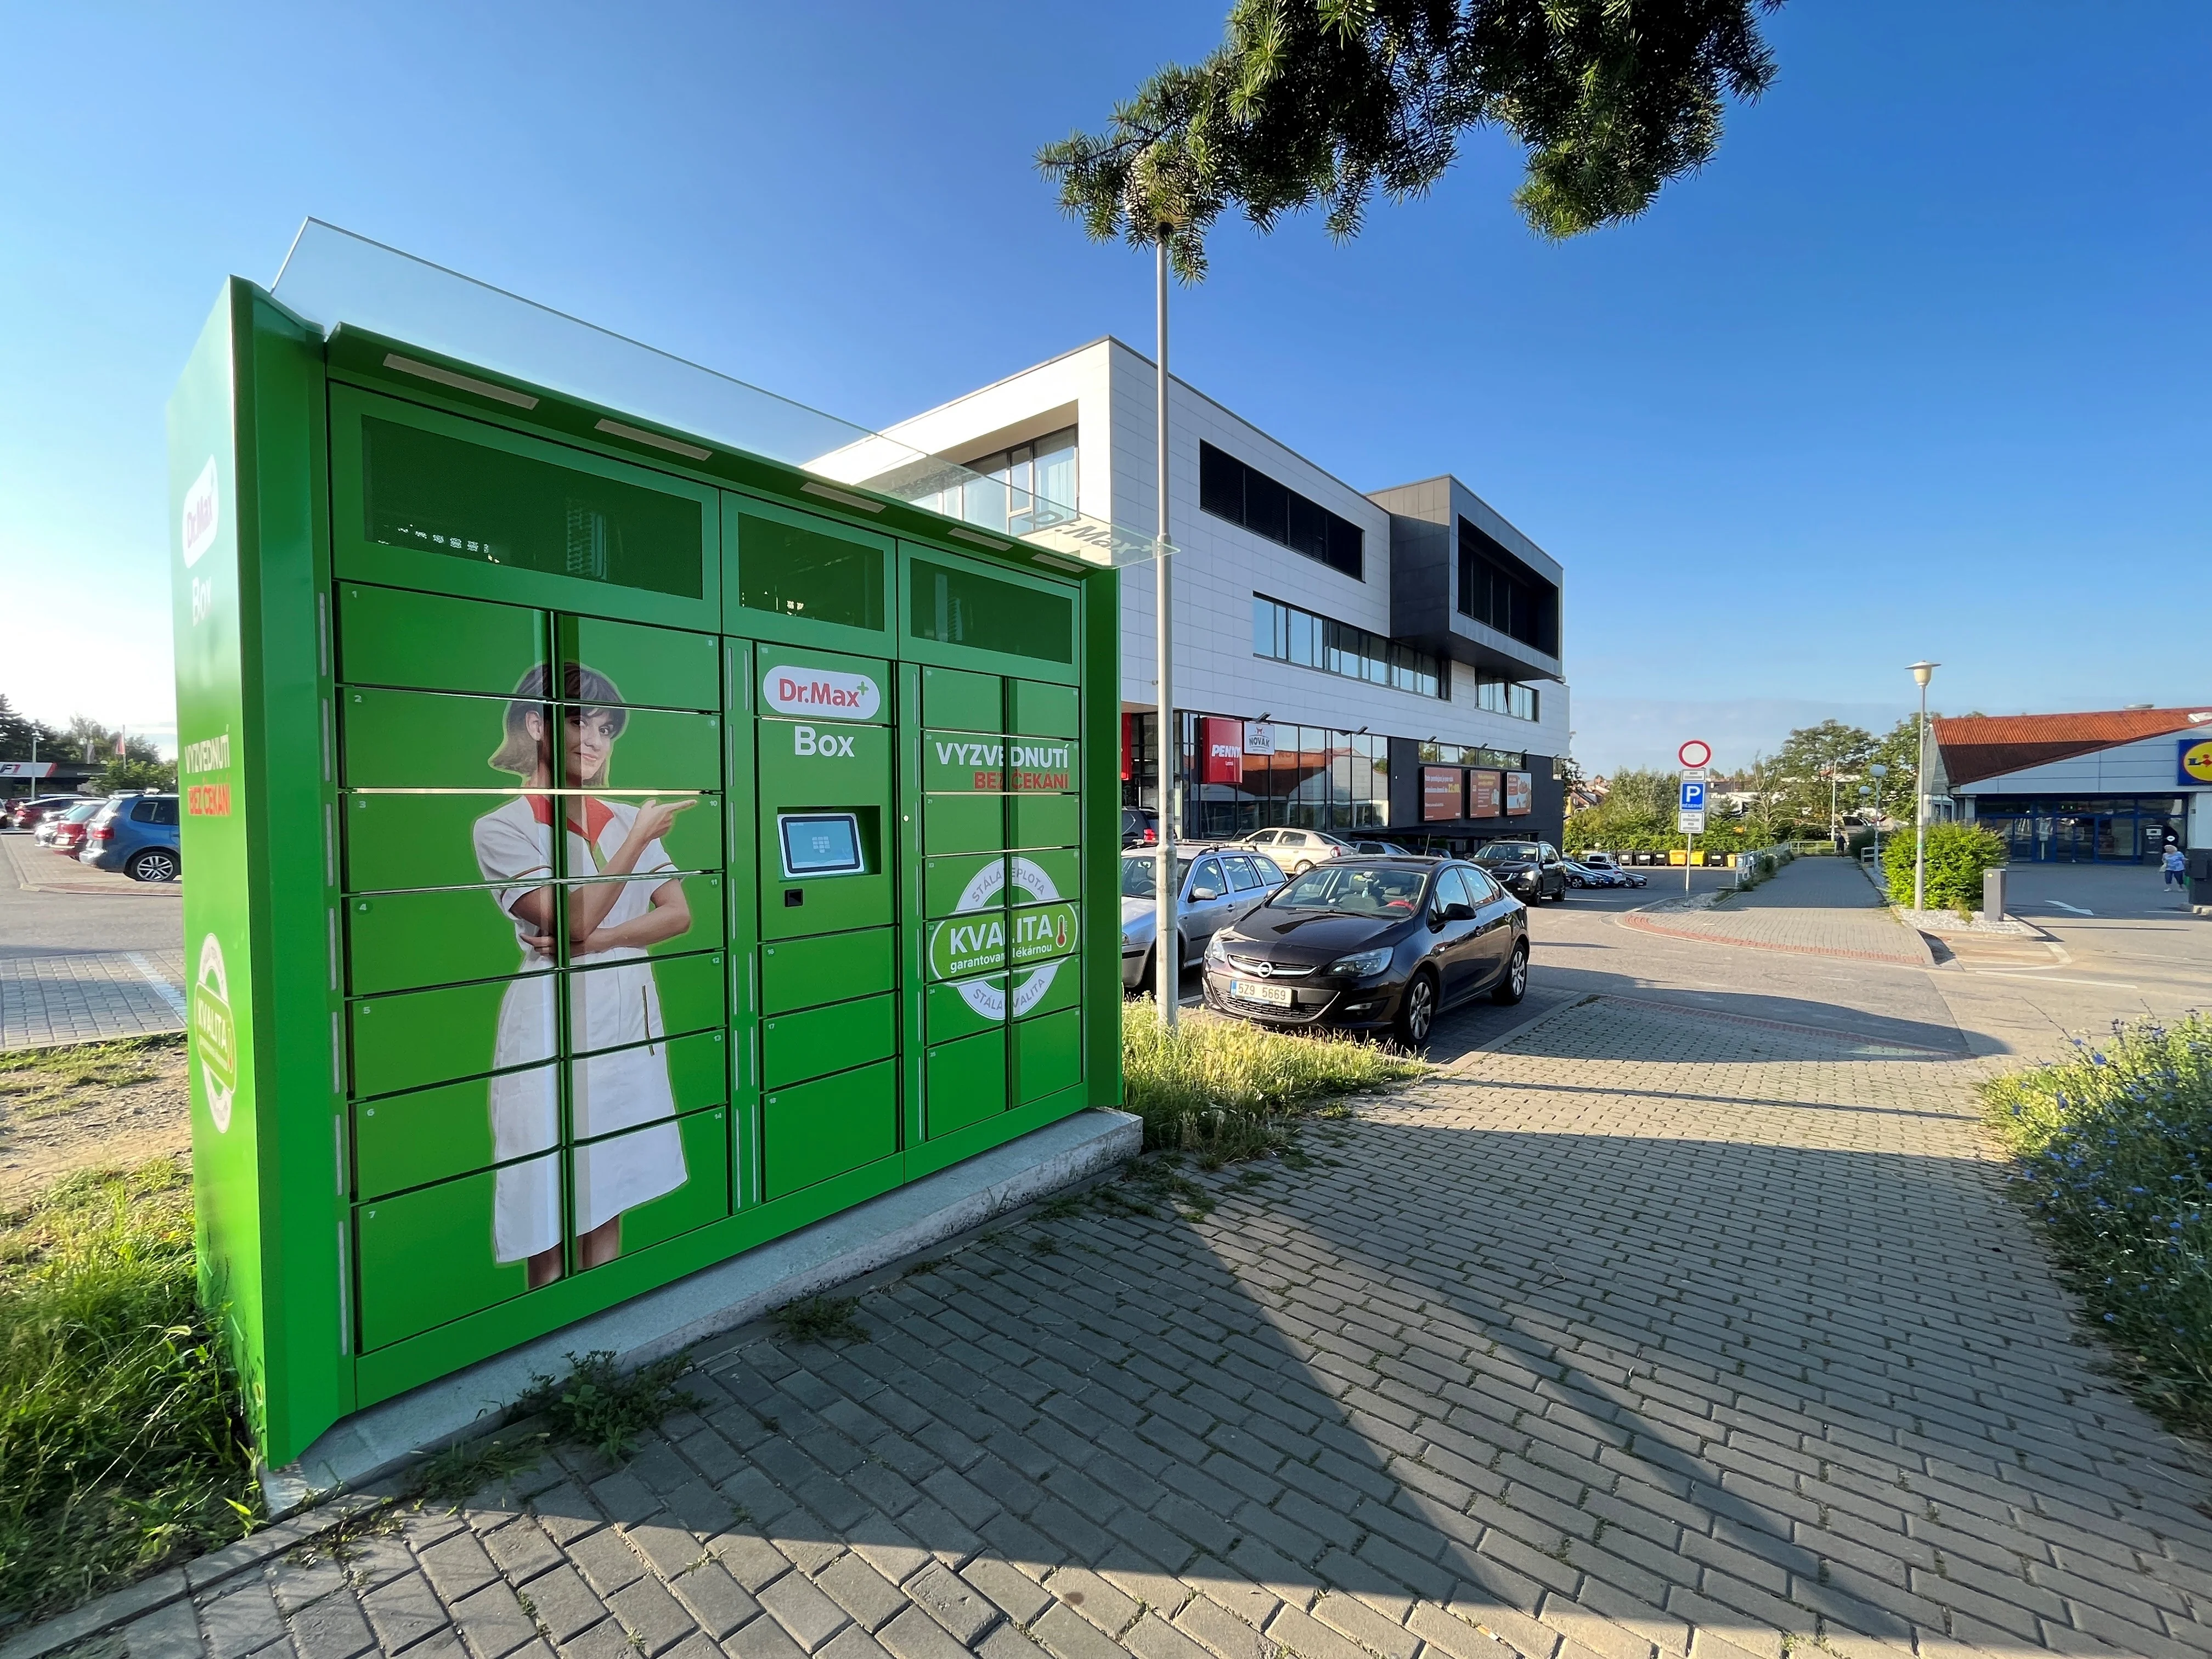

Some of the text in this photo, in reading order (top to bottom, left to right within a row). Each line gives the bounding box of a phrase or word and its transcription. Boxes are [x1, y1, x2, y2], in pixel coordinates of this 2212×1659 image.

[352, 590, 357, 599] 1
[354, 695, 362, 703] 2
[780, 678, 860, 708] Dr.Max
[184, 724, 230, 774] VYZVEDNUTÍ
[795, 725, 855, 758] Box
[1211, 744, 1241, 758] PENNY
[1012, 768, 1069, 790] ČEKÁNÍ
[1686, 785, 1701, 803] P
[359, 800, 366, 809] 3
[972, 867, 1045, 902] STÁLÁ EPLOTA
[950, 944, 1052, 973] garantovan lékárnou
[1013, 978, 1045, 1008] VALITA
[1238, 983, 1255, 996] 5Z9
[1262, 987, 1286, 1001] 5669
[363, 1006, 371, 1014] 5
[366, 1108, 375, 1116] 6
[369, 1210, 376, 1218] 7
